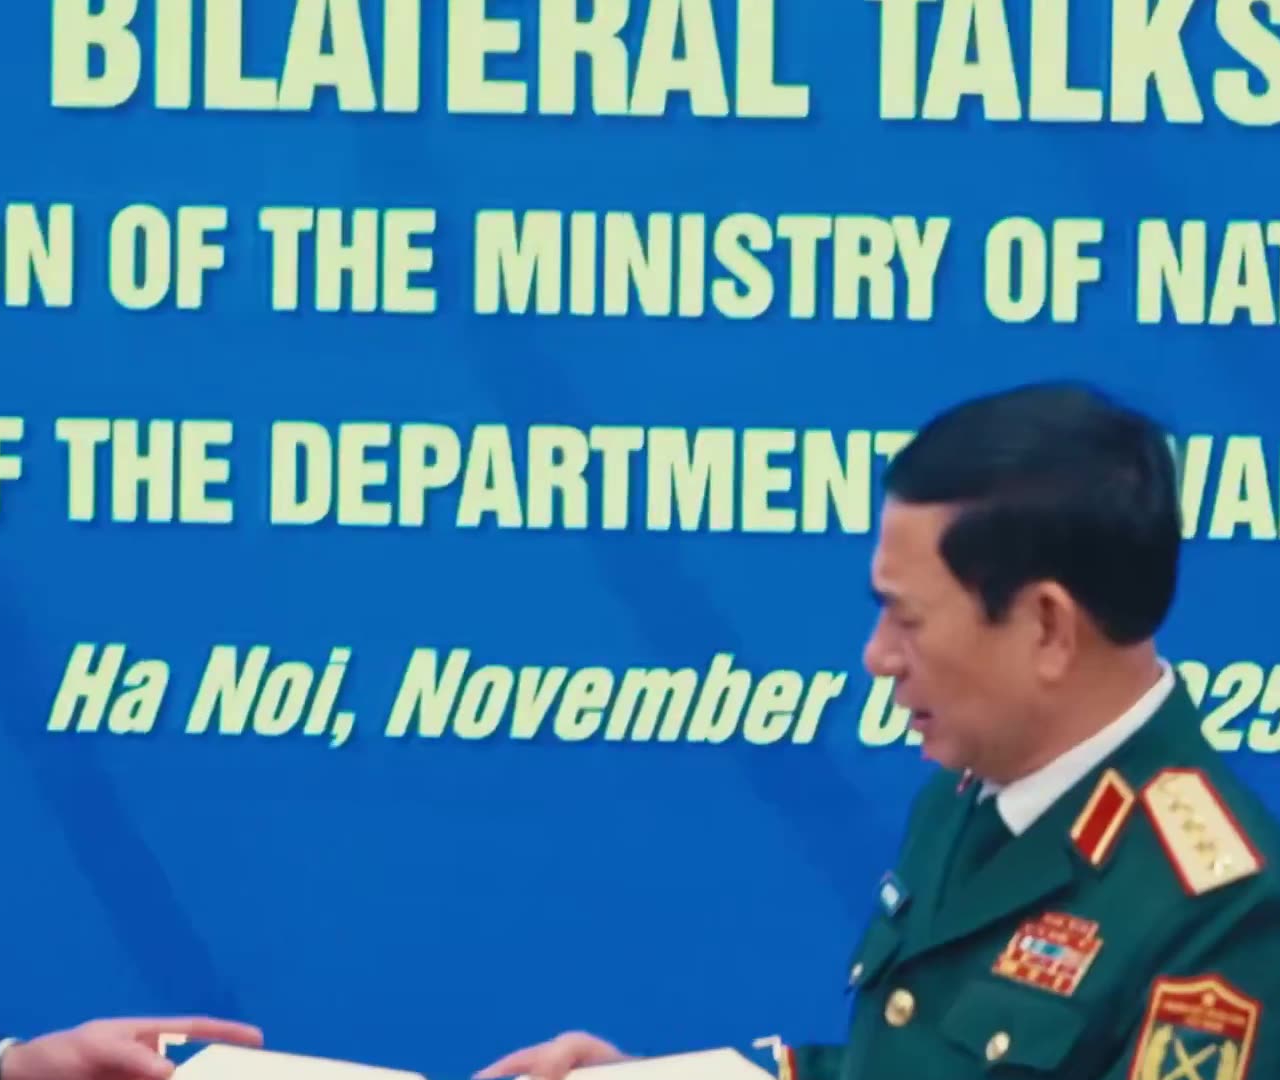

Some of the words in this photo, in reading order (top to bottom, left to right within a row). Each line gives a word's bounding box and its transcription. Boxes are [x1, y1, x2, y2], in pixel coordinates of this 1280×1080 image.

[52, 0, 810, 118] BILATERAL
[109, 204, 228, 310] OF
[259, 208, 437, 313] THE
[474, 210, 951, 321] MINISTRY
[985, 217, 1103, 323] OF
[55, 419, 234, 524] THE
[47, 643, 169, 734] Ha
[186, 645, 355, 747] Noi,
[385, 648, 848, 745] November
